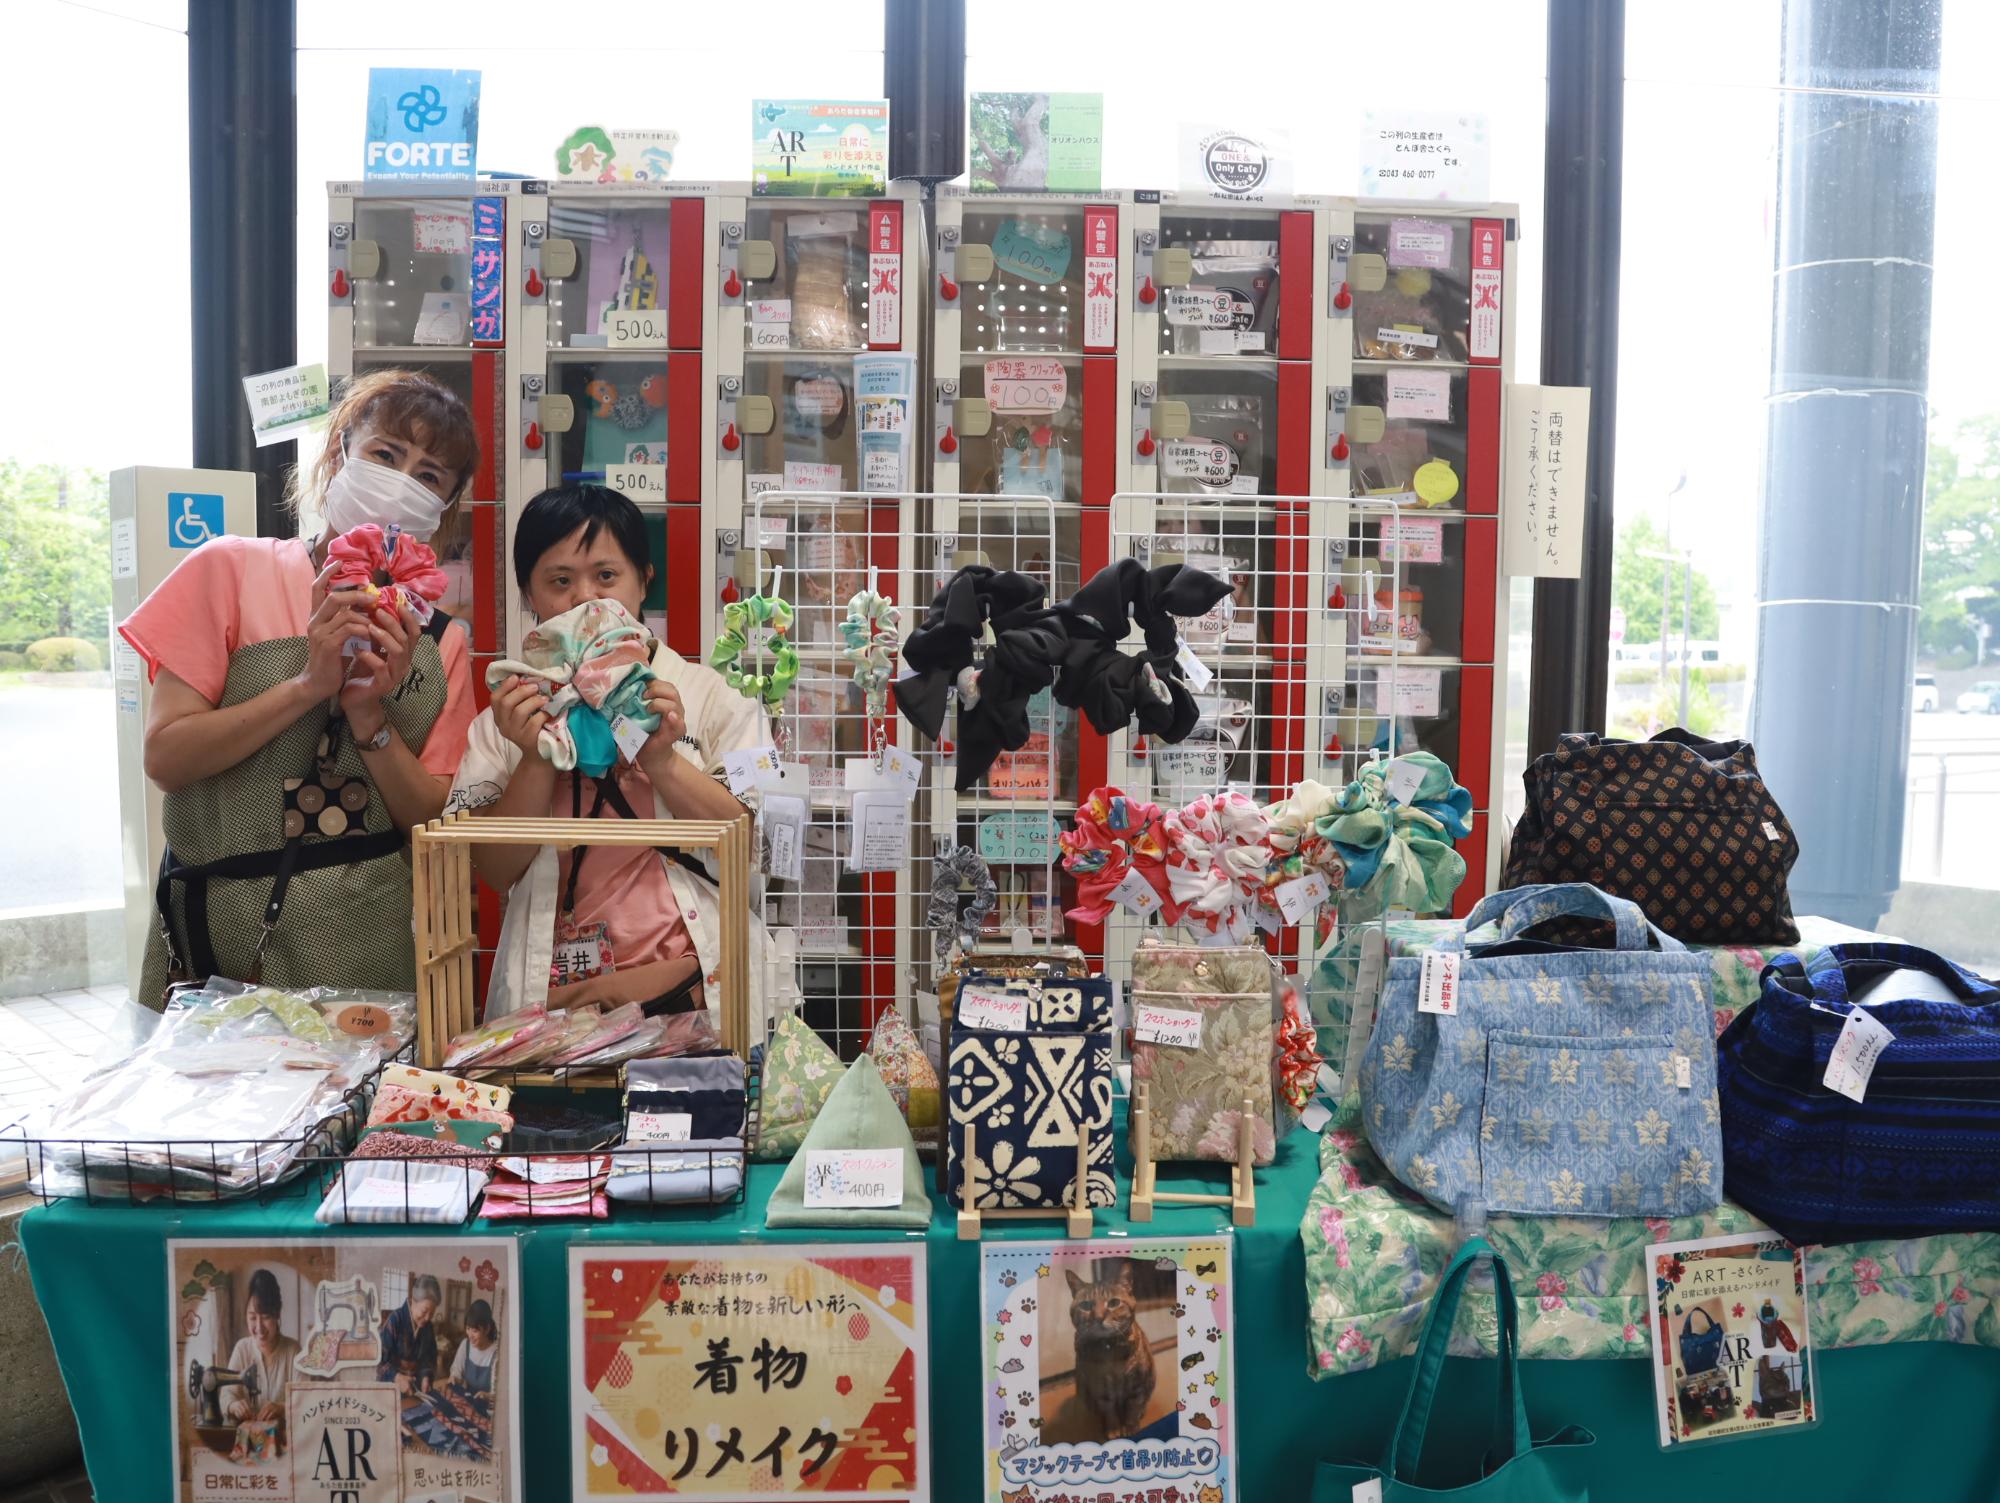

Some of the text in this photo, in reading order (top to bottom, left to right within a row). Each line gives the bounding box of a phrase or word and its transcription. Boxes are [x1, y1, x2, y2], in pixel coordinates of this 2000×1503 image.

[1051, 136, 1099, 145] オリオンハウス
[1379, 130, 1443, 141] この列の生産者は
[367, 141, 471, 167] FORTE
[822, 150, 884, 161] 彩りを添える
[1395, 144, 1451, 154] とんぼ舎さくら
[367, 171, 397, 181] Expand
[399, 171, 419, 181] Your
[1215, 163, 1258, 174] Only Cafe
[872, 257, 898, 265] あぶない
[1088, 261, 1113, 269] あぶない
[473, 203, 500, 338] ミサンガ
[616, 319, 667, 341] 500えん
[757, 329, 789, 345] 600円
[997, 361, 1059, 380] 陶器 クリップ
[1002, 385, 1057, 409] 100円
[1204, 466, 1225, 476] ¥600
[1527, 409, 1541, 543] ご了承ください。
[615, 473, 664, 491] 500えん
[1545, 411, 1564, 566] 両替はできません。
[848, 1183, 885, 1198] 400円
[662, 1271, 768, 1287] あなたがお待ちの
[1693, 1267, 1726, 1284] ART
[1681, 1279, 1781, 1299] 日常に彩を添えるハンドメイド
[665, 1293, 861, 1318] 素敵な着物を新しい形へ
[1719, 1336, 1754, 1364] AR
[692, 1337, 808, 1395] 着物
[303, 1396, 386, 1424] ハンドメイドショップ
[324, 1416, 344, 1425] SINCE
[311, 1426, 378, 1481] AR
[664, 1425, 839, 1481] リメイク
[1012, 1446, 1197, 1476] マジックテープで首吊り防止
[204, 1473, 280, 1491] 日常に彩を
[413, 1468, 493, 1489] 思い出を形に
